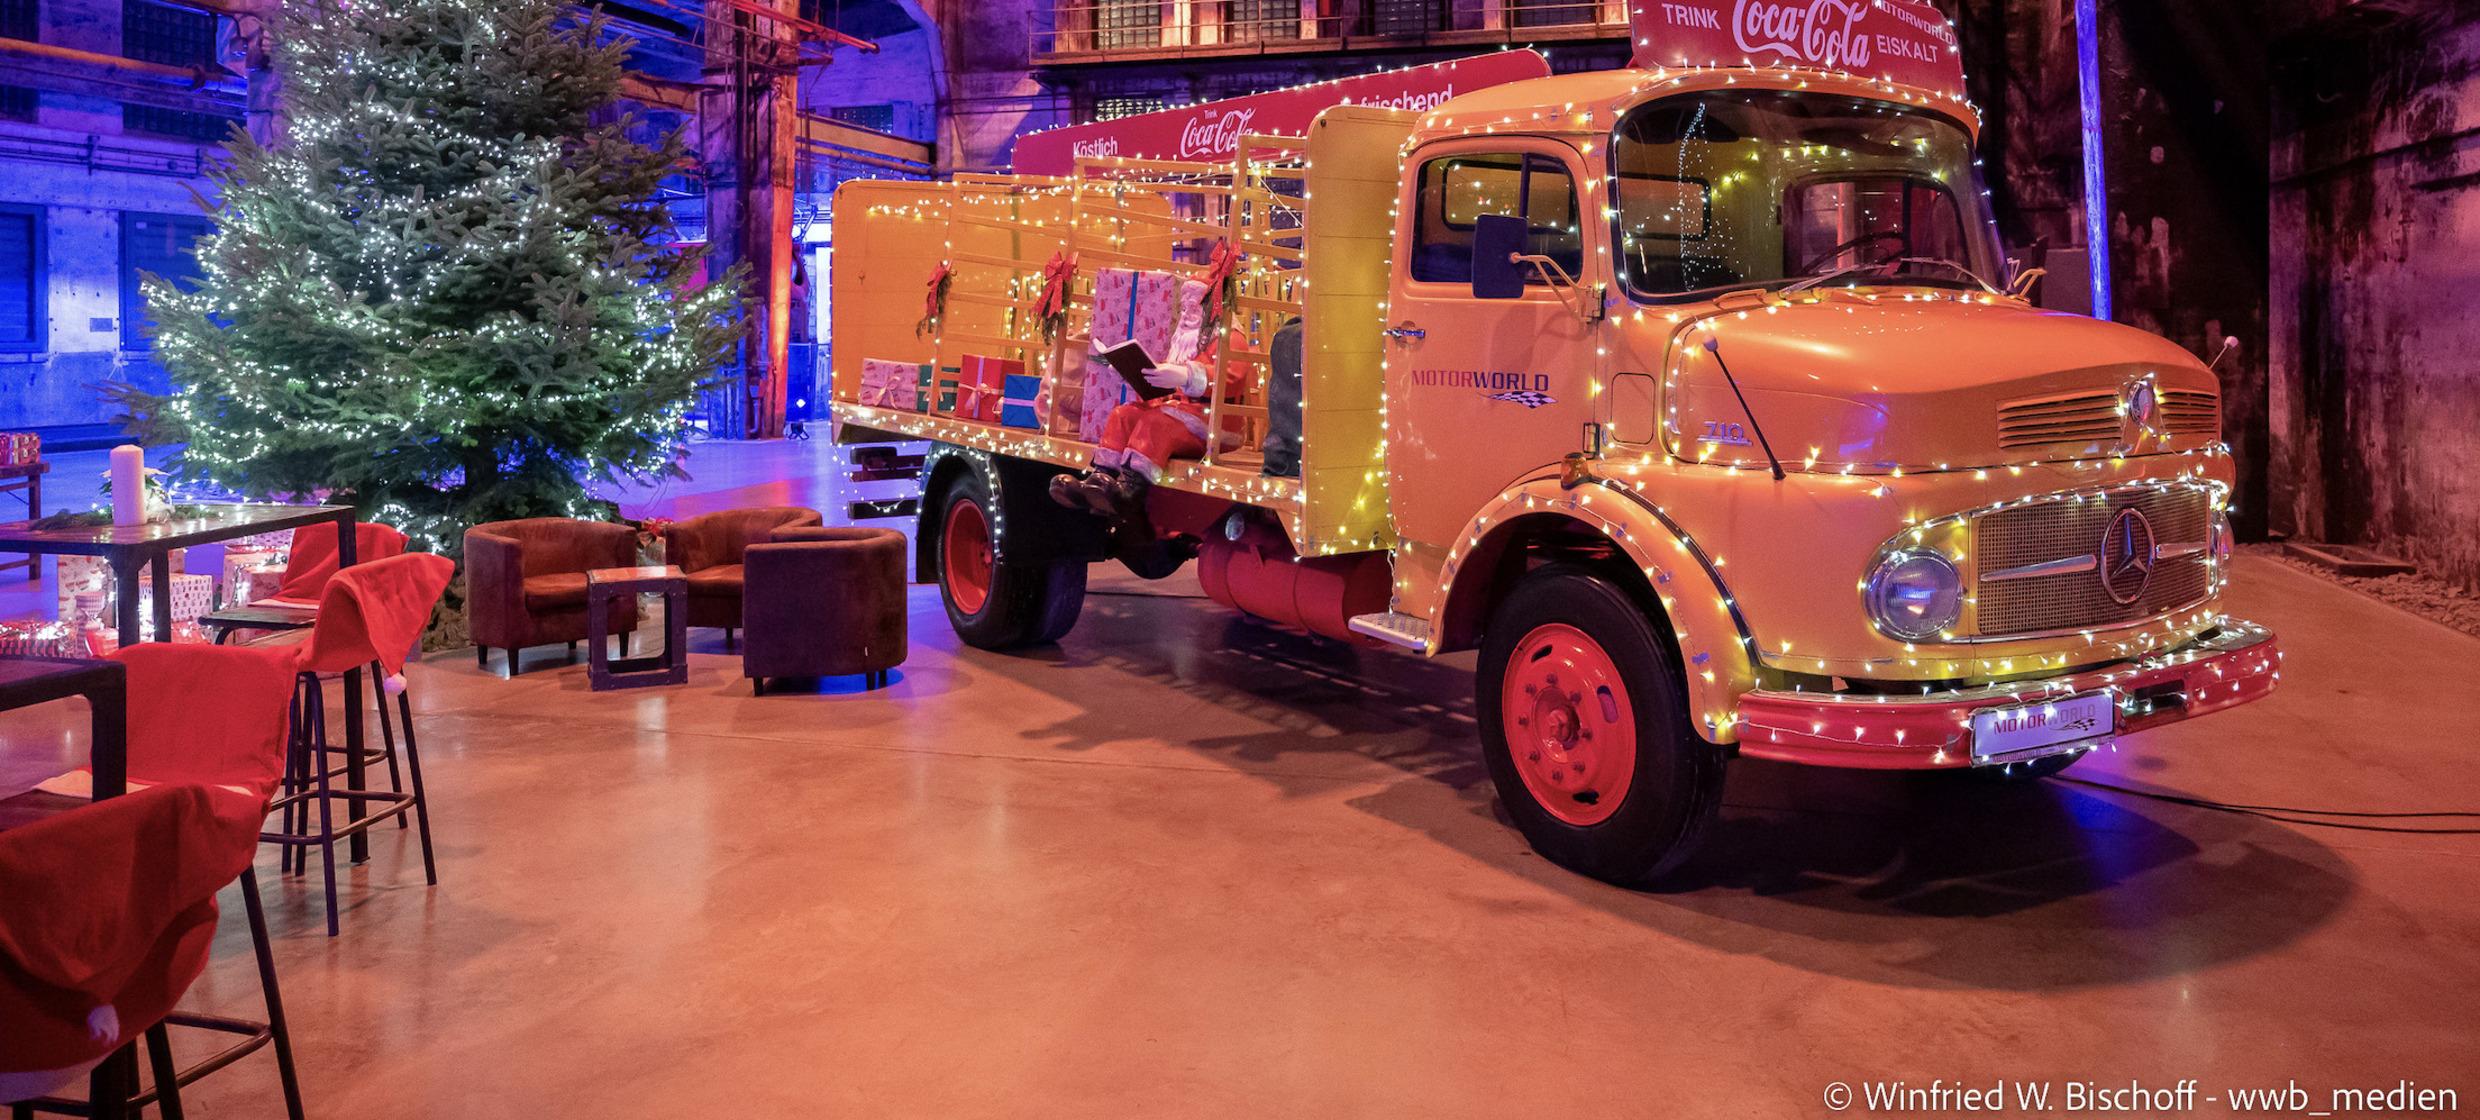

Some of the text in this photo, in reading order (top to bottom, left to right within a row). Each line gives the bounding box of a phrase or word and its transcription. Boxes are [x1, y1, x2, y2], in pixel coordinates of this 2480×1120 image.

[1661, 0, 1938, 68] TRINK Coca-Cola EISKALT
[1073, 136, 1118, 160] Köstlich
[1412, 370, 1549, 392] MOTORWORLD
[1703, 420, 1744, 440] 710
